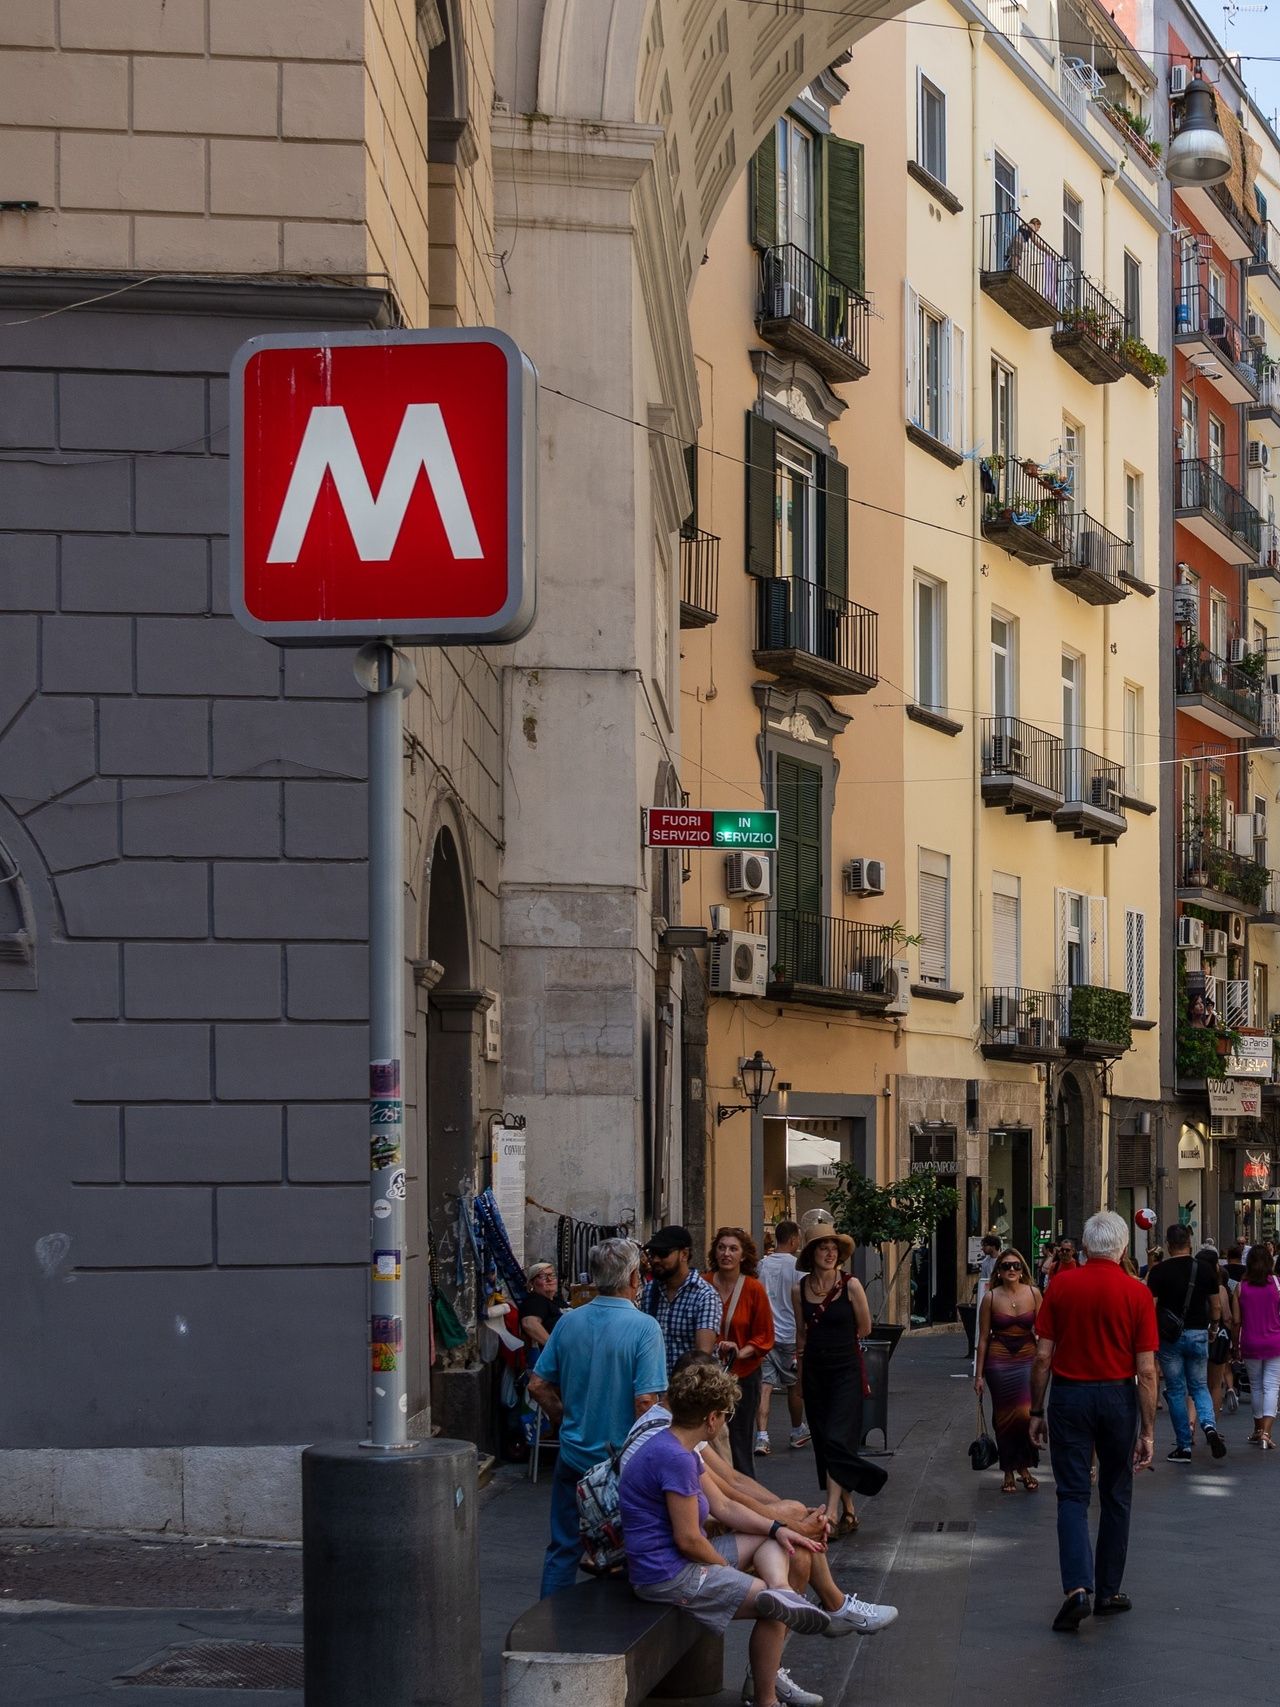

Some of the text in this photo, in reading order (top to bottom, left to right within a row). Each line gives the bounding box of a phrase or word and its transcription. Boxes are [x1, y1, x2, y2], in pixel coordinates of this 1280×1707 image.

[267, 403, 484, 563] M
[662, 816, 700, 826] FUORI
[738, 818, 751, 828] IN
[652, 830, 710, 842] SERVIZIO
[716, 831, 773, 844] SERVIZIO
[1250, 1038, 1268, 1047] Parisi
